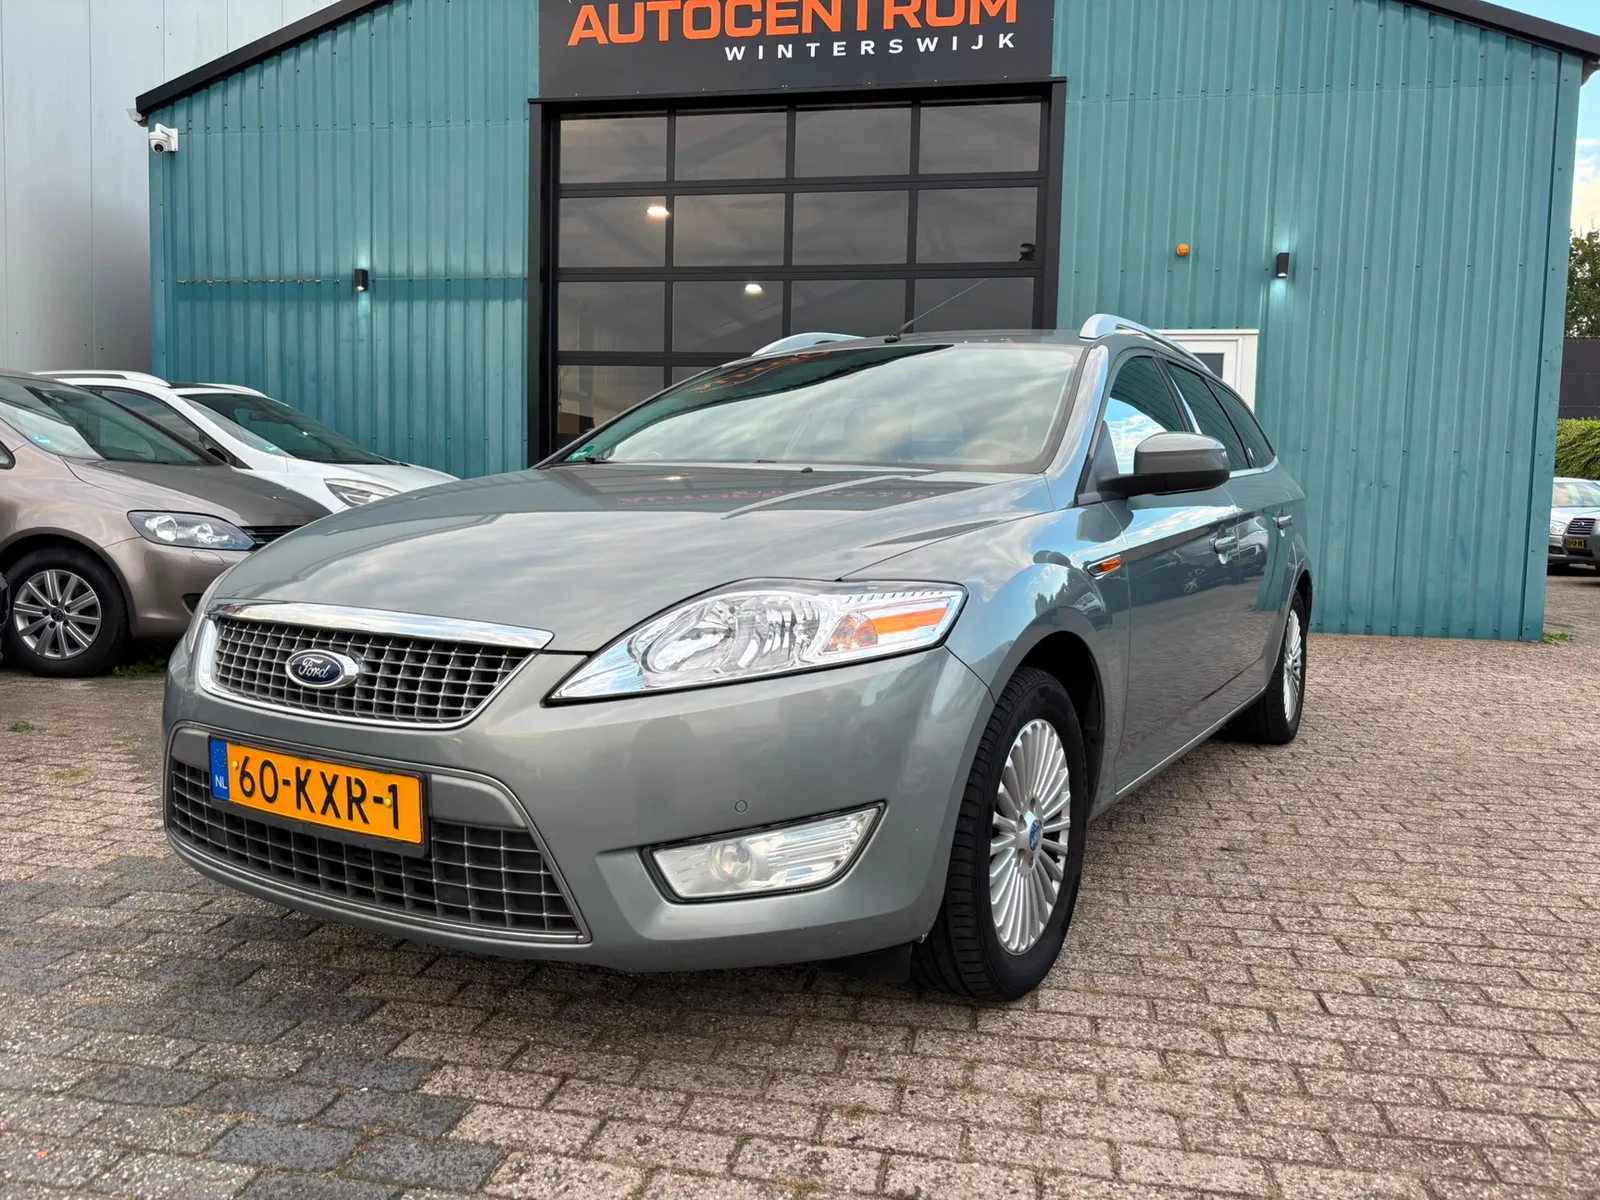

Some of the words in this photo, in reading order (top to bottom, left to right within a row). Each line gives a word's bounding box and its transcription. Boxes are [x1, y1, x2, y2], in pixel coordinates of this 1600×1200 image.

[567, 0, 1018, 46] AUTOCENTRUM
[724, 32, 1015, 61] WINTERSWIJK
[297, 658, 331, 679] Ford
[215, 774, 228, 790] NL
[239, 755, 400, 830] 60-KXR-1
